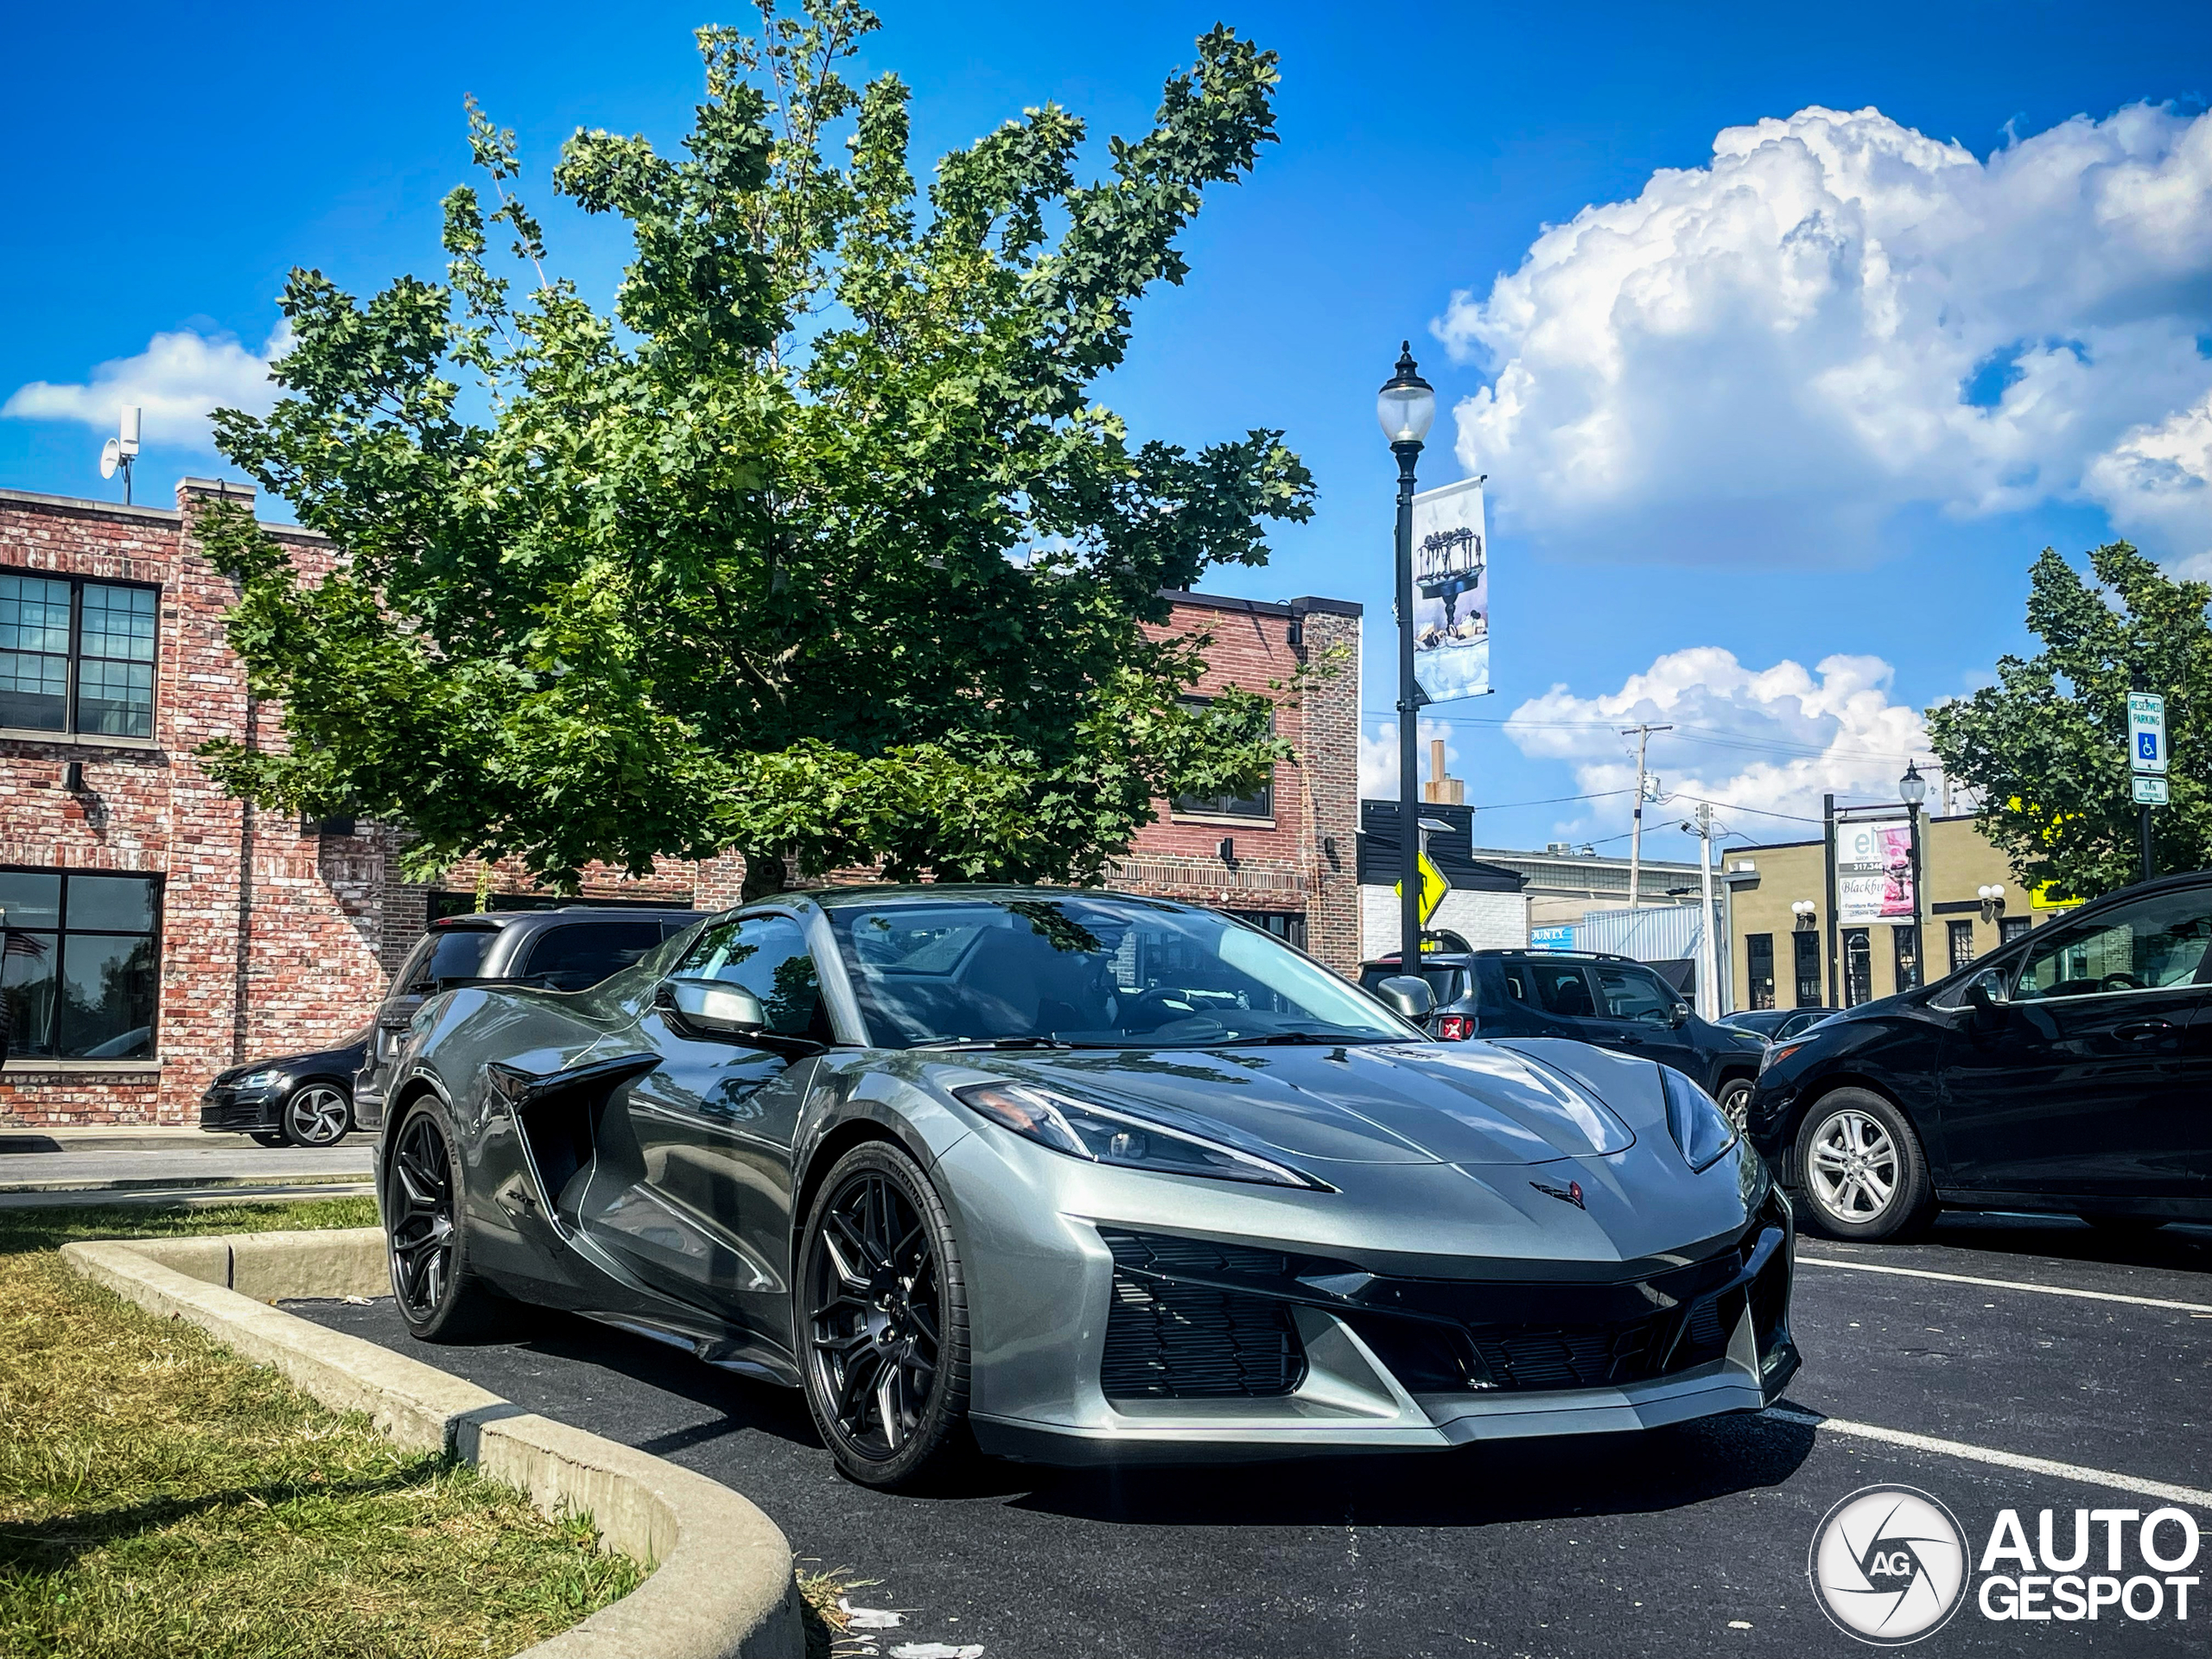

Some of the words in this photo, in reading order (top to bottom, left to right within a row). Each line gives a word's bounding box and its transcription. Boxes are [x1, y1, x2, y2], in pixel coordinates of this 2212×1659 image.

[2131, 701, 2161, 712] RESERVED
[2133, 713, 2159, 726] PARKING
[2144, 783, 2157, 791] VAN
